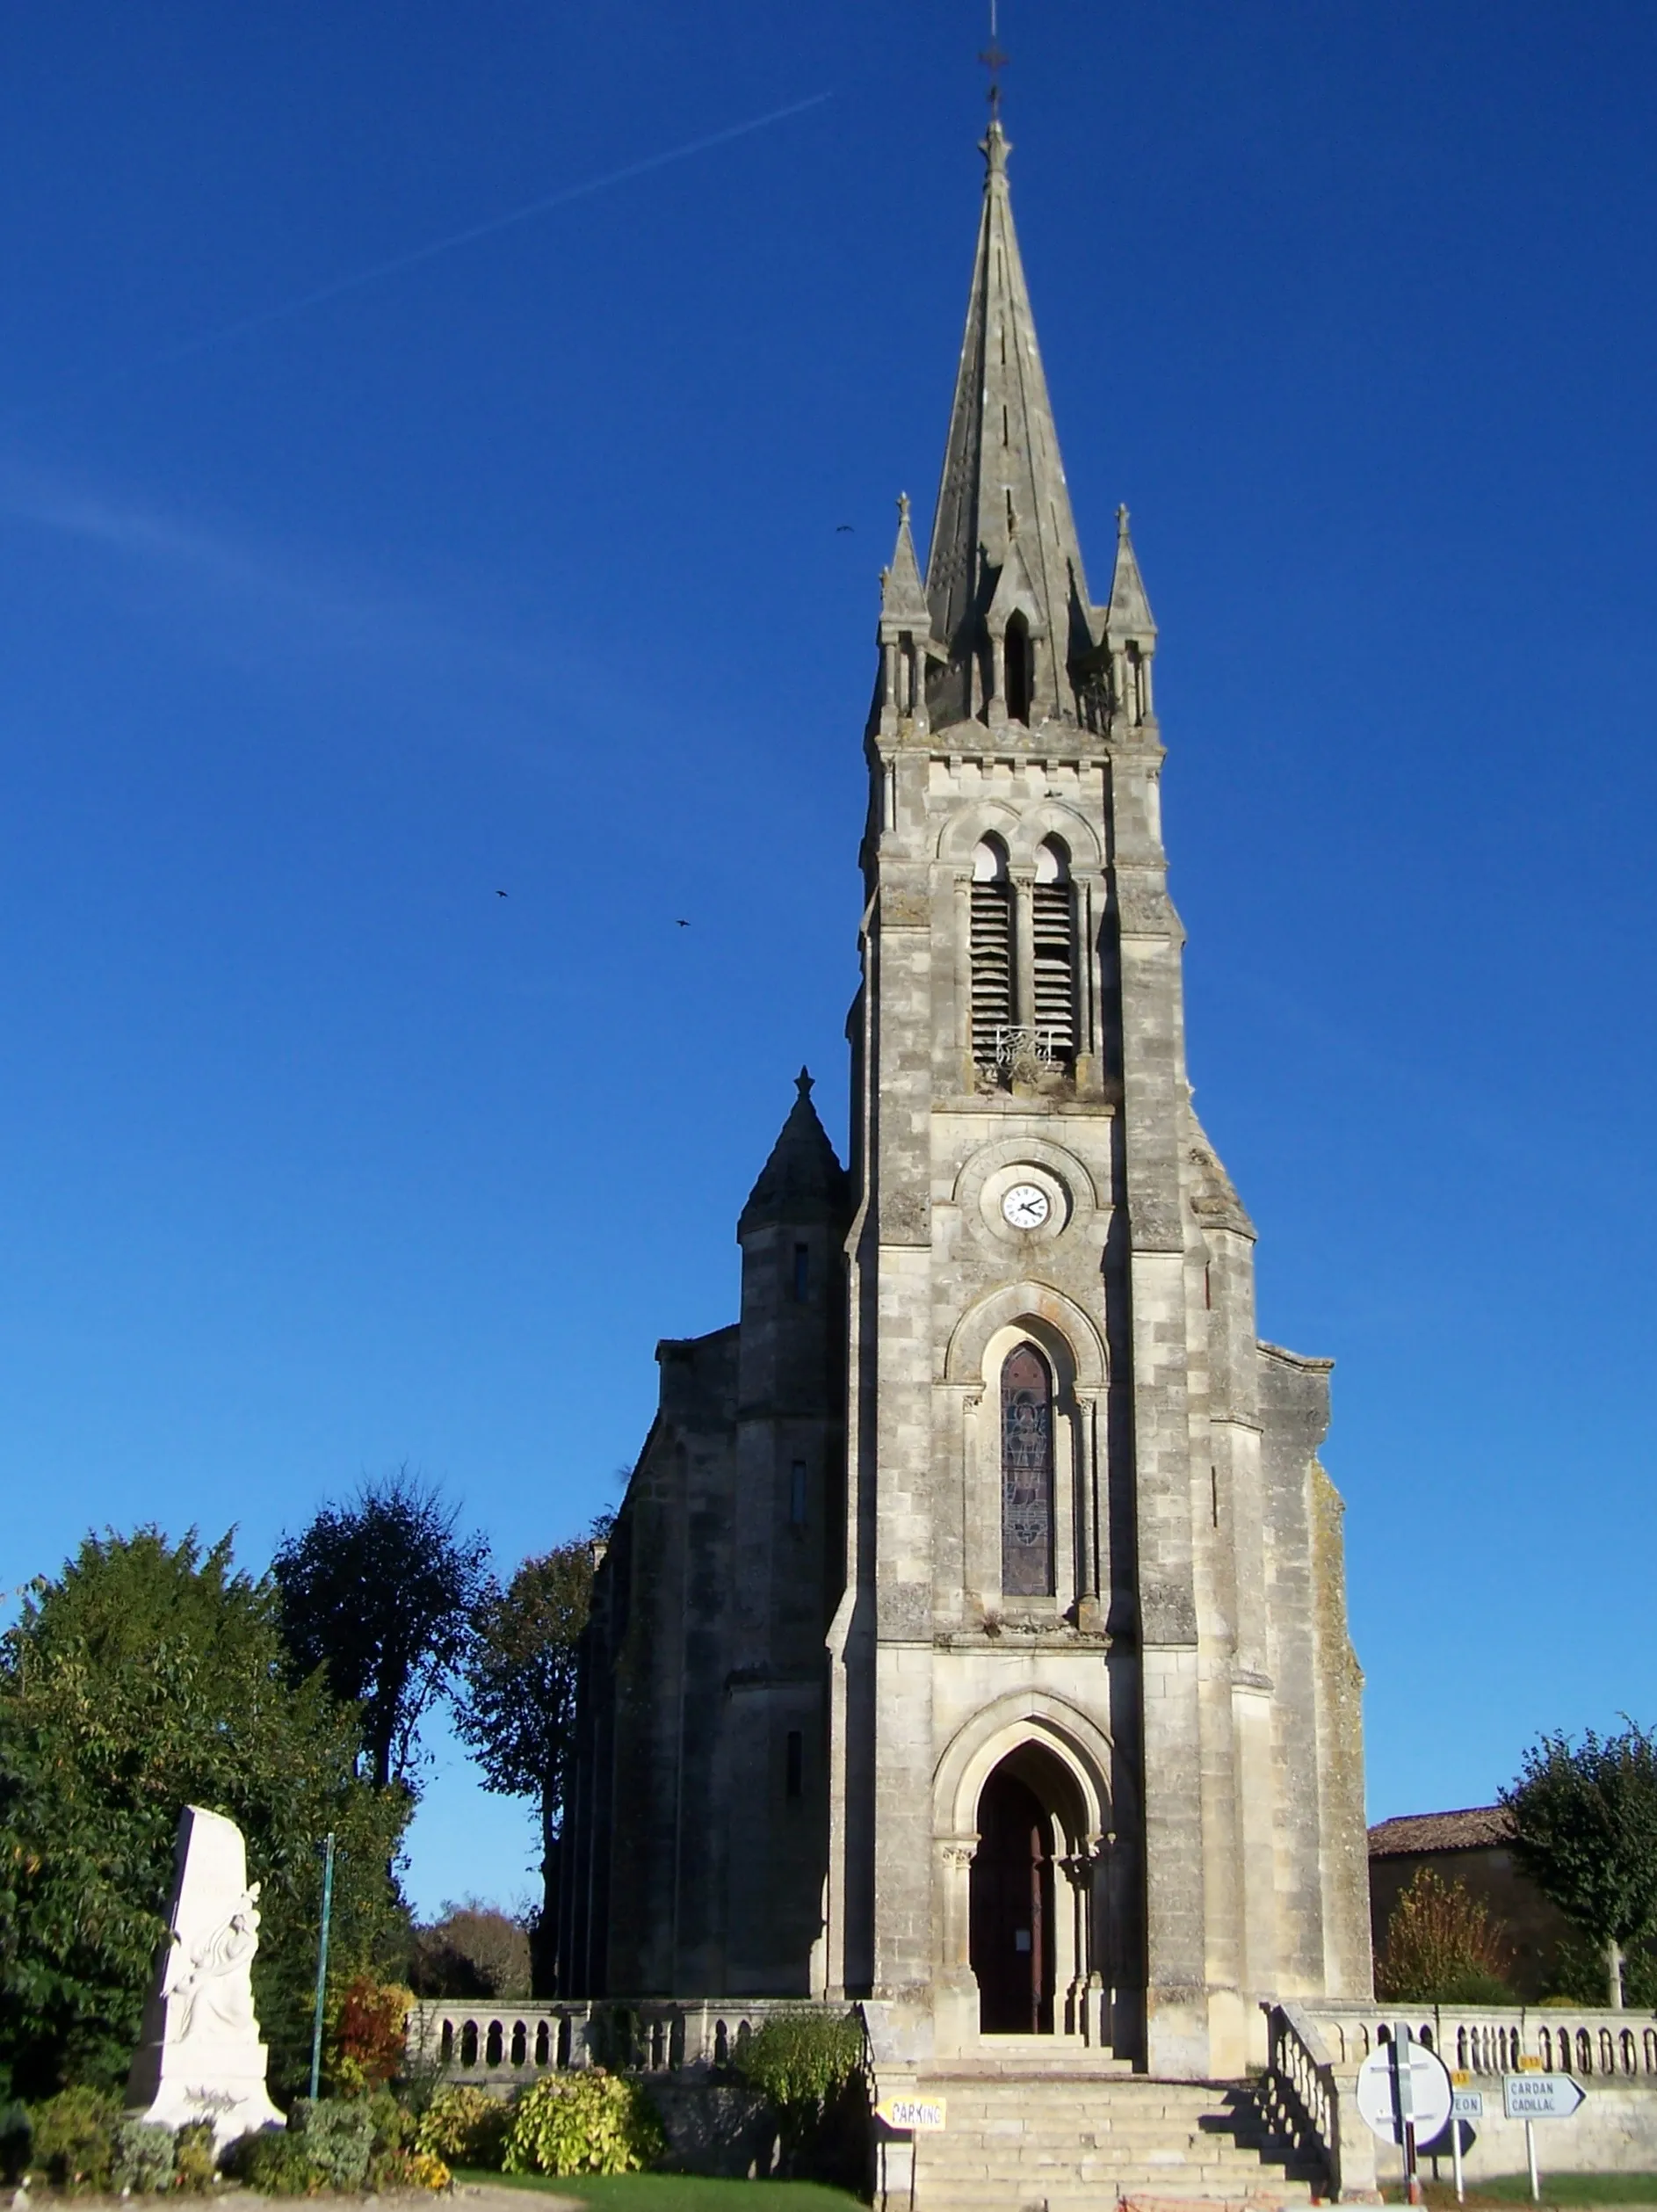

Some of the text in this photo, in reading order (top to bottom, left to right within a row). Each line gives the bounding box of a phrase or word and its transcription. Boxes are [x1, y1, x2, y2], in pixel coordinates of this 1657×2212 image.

[1511, 2084, 1553, 2095] CARDAN
[1455, 2098, 1478, 2111] EON
[1512, 2099, 1555, 2111] CADILLAC
[893, 2102, 940, 2123] PARKING
